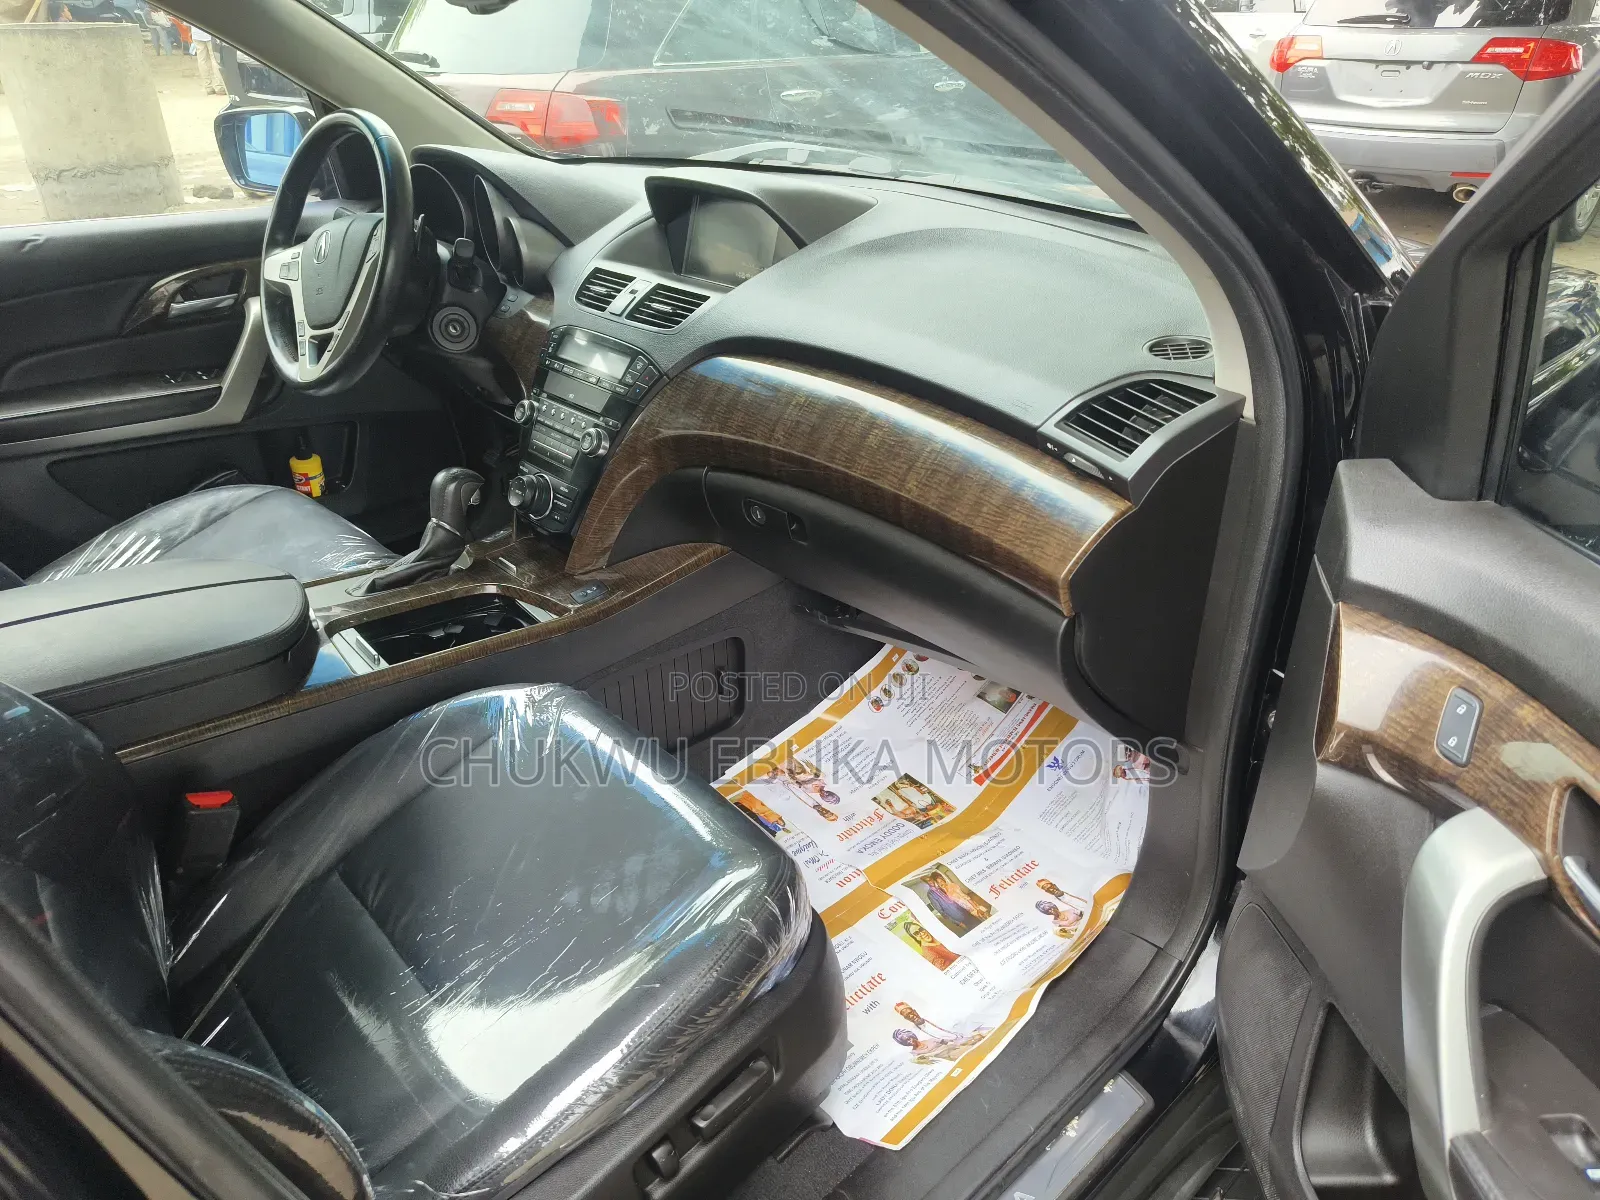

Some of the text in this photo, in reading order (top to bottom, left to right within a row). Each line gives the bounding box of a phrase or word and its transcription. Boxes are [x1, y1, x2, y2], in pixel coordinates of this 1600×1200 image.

[836, 808, 884, 842] Felicitate
[836, 868, 862, 888] tion
[988, 859, 1040, 900] Felicitate
[845, 972, 887, 1010] licitate
[862, 1000, 880, 1014] with
